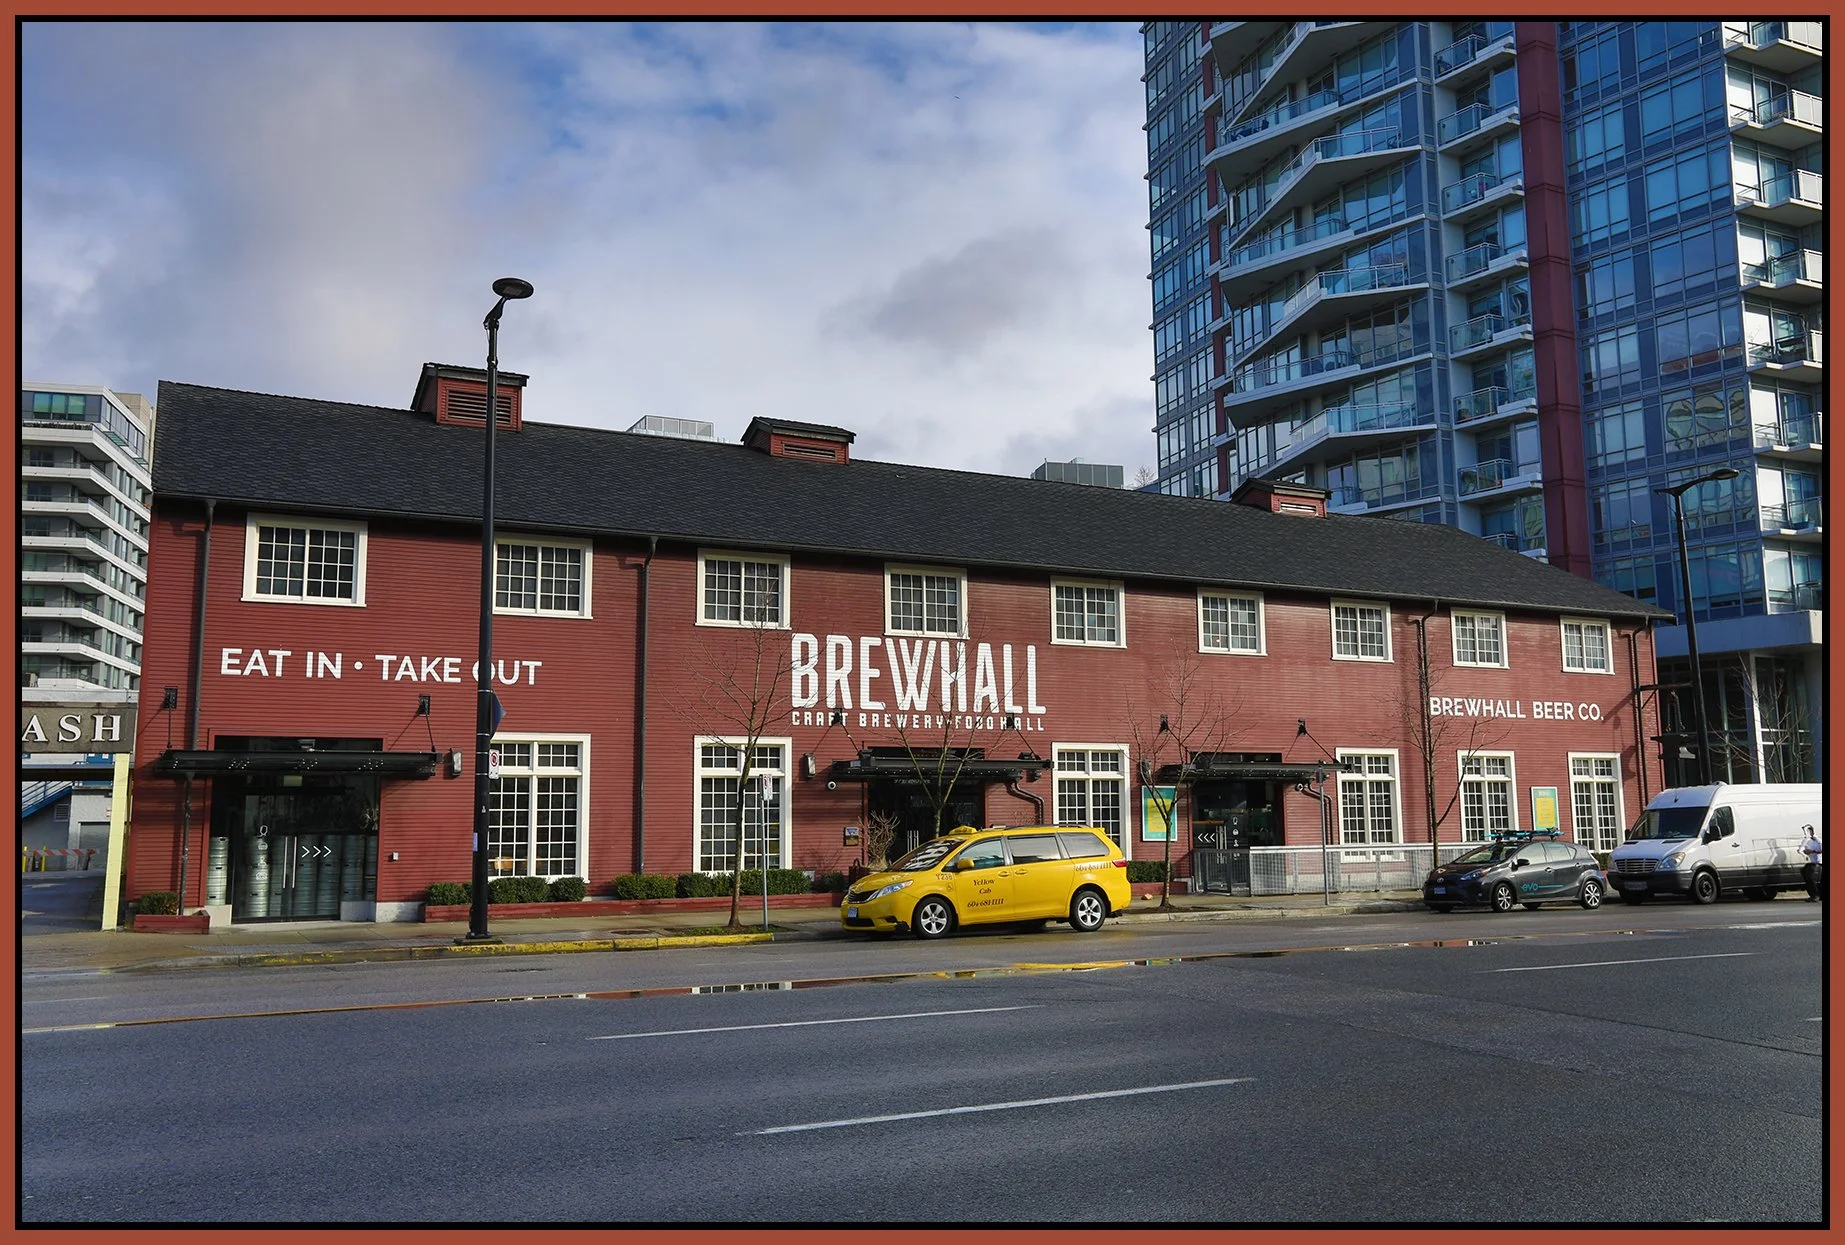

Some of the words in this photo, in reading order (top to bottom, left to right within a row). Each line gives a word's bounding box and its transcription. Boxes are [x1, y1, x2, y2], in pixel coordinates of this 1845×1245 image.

[221, 647, 292, 677] EAT
[306, 651, 342, 679] IN
[375, 654, 462, 683] TAKE
[791, 633, 1047, 714] BREWHALL
[791, 711, 849, 727] CRAFT
[999, 716, 1045, 731] HALL
[1429, 697, 1527, 719] BREWHALL
[1532, 701, 1575, 720] BEER
[1578, 702, 1604, 721] CO.
[1521, 883, 1539, 891] evo
